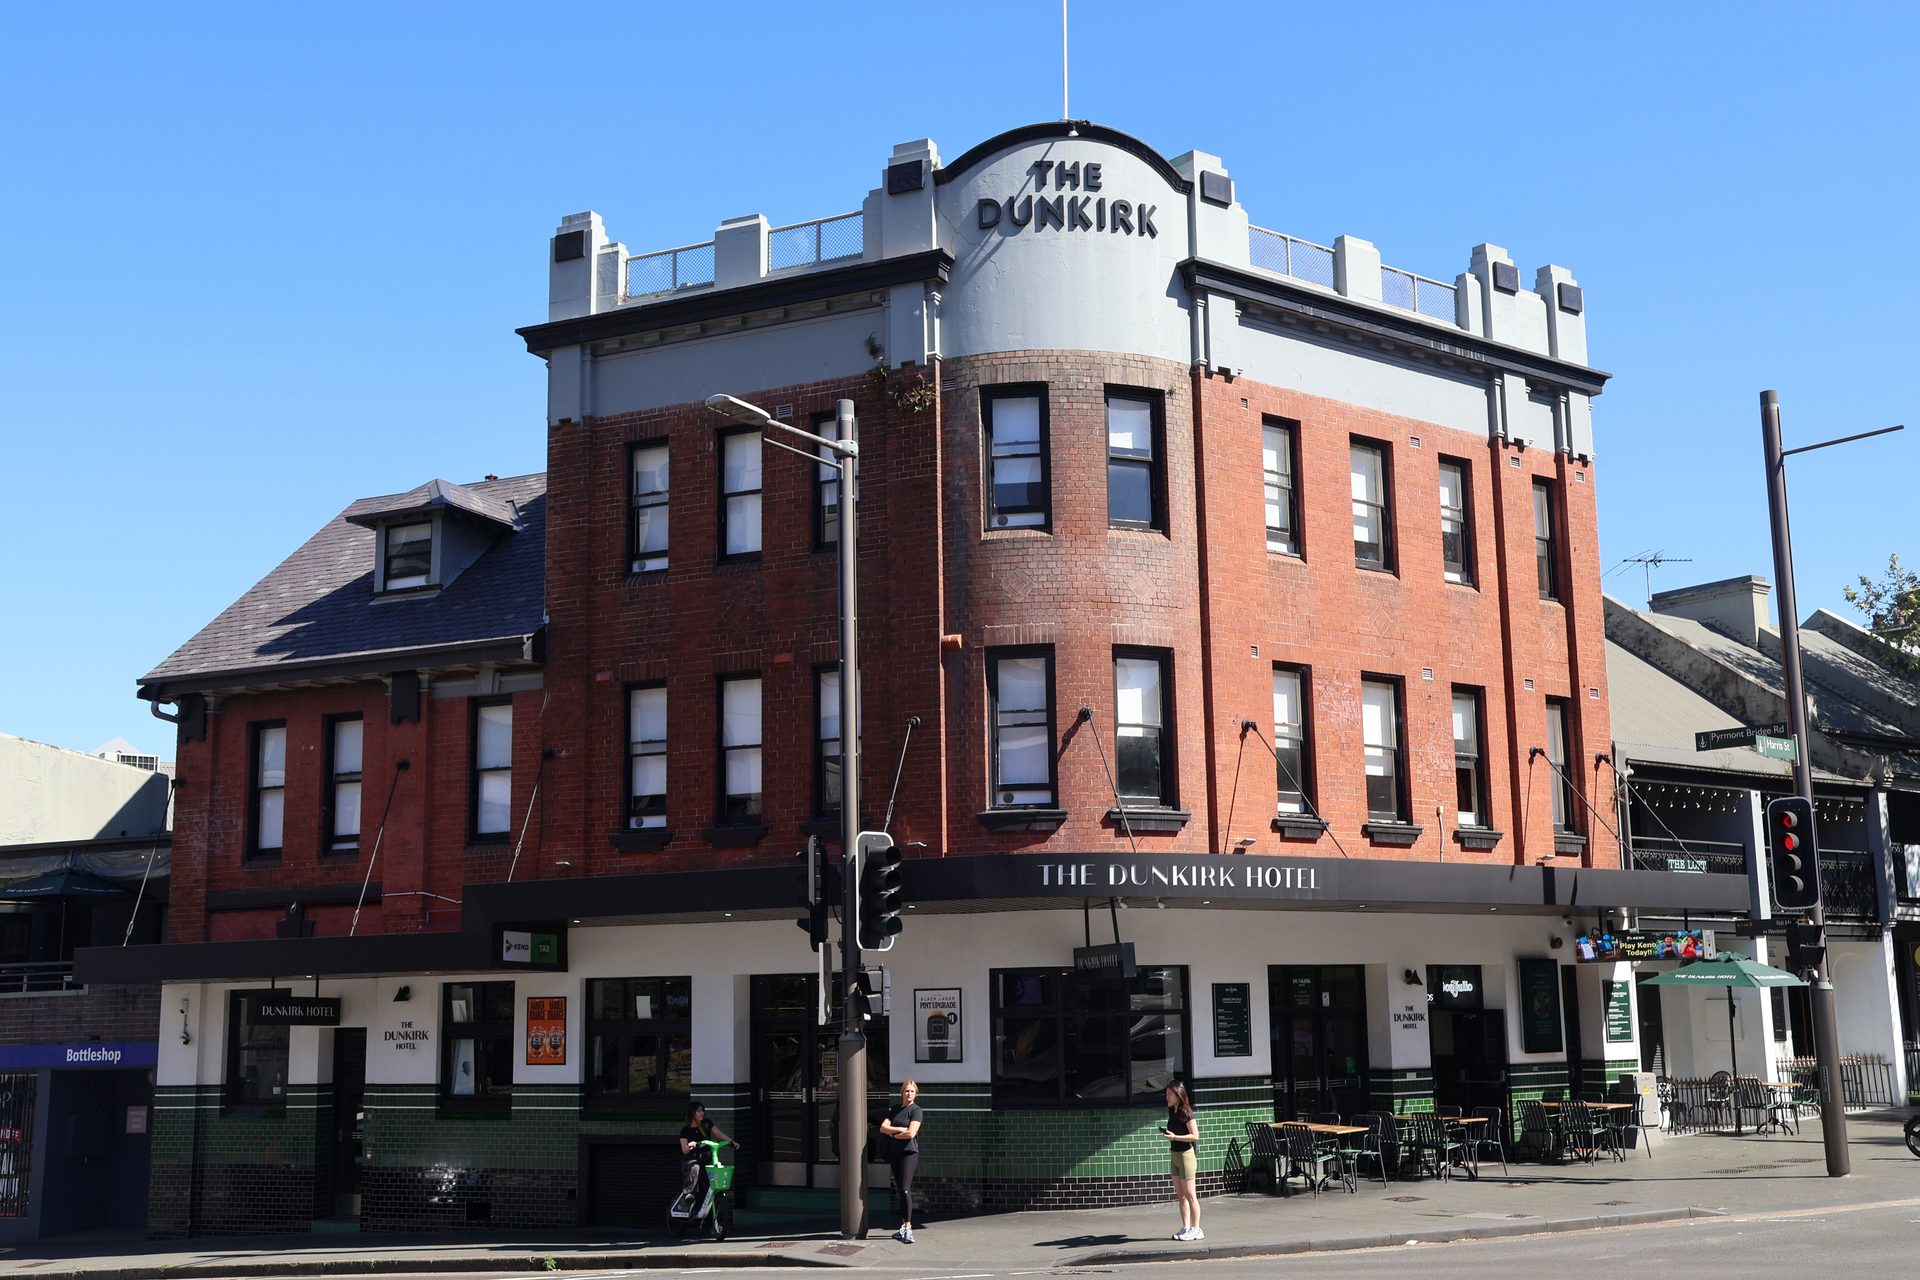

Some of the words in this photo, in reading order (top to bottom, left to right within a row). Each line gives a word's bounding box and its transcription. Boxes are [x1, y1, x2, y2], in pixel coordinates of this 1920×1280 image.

[1035, 160, 1102, 188] THE
[977, 194, 1158, 239] DUNKIRK
[1711, 731, 1744, 742] Pyrmont
[1746, 728, 1771, 737] Bridge
[1773, 725, 1784, 734] Rd
[1766, 739, 1783, 750] Harris
[1783, 741, 1790, 751] St
[1668, 859, 1685, 869] THE
[1037, 864, 1096, 886] THE
[1109, 864, 1235, 887] DUNKIRK
[1247, 866, 1320, 889] HOTEL
[513, 943, 529, 951] KENO
[538, 944, 550, 953] TAB
[1620, 942, 1635, 950] Play
[1637, 941, 1656, 949] Keno
[1626, 949, 1652, 957] Today!!
[262, 1005, 304, 1016] DUNKIRK
[306, 1006, 335, 1017] HOTEL
[1393, 1013, 1426, 1022] DUNKIRK
[384, 1031, 429, 1041] DUNKIRK
[66, 1047, 121, 1064] Bottleshop
